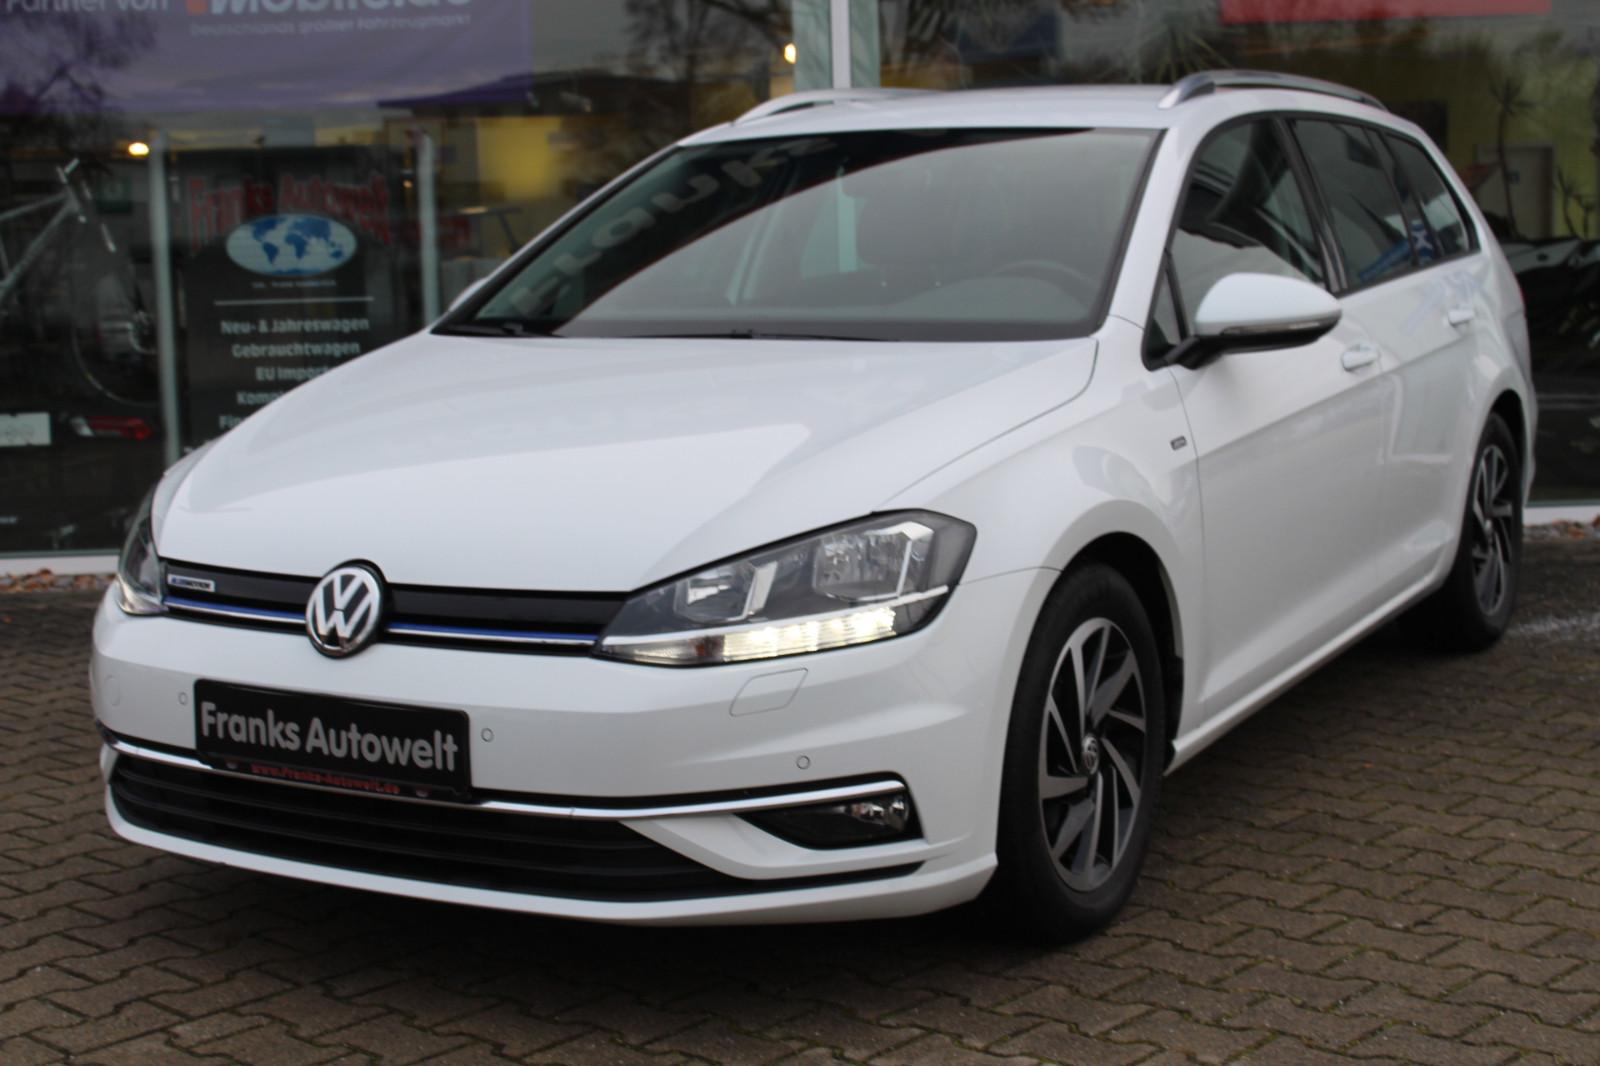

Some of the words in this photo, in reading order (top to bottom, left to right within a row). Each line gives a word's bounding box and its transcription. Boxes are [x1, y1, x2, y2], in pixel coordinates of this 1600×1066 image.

[220, 320, 257, 335] Neu-
[259, 320, 269, 334] &
[271, 317, 370, 335] Jahreswagen
[231, 341, 361, 358] Gebrauchtwagen
[255, 366, 276, 381] EU
[201, 701, 300, 750] Franks
[305, 717, 459, 771] Autowelt
